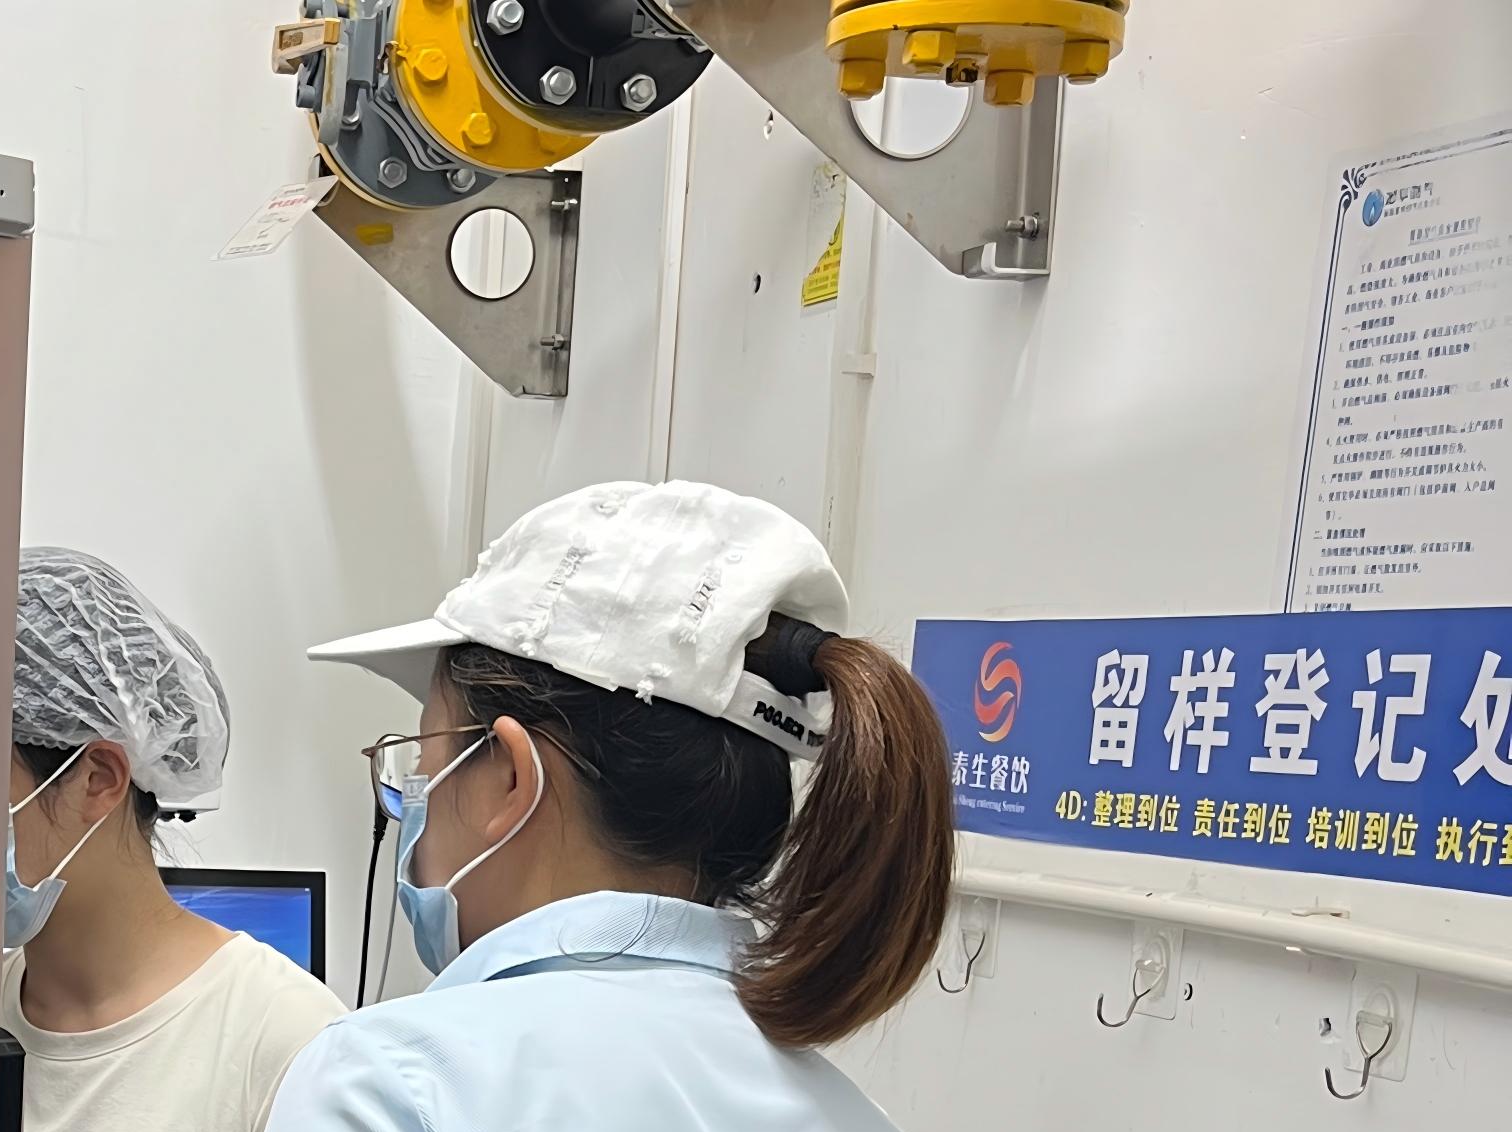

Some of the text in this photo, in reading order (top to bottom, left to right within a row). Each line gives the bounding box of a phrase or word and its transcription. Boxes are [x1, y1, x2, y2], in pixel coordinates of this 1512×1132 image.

[951, 750, 1030, 794] 泰生餐饮
[1193, 798, 1292, 844] 责任到位
[1305, 806, 1419, 856] 培训到位
